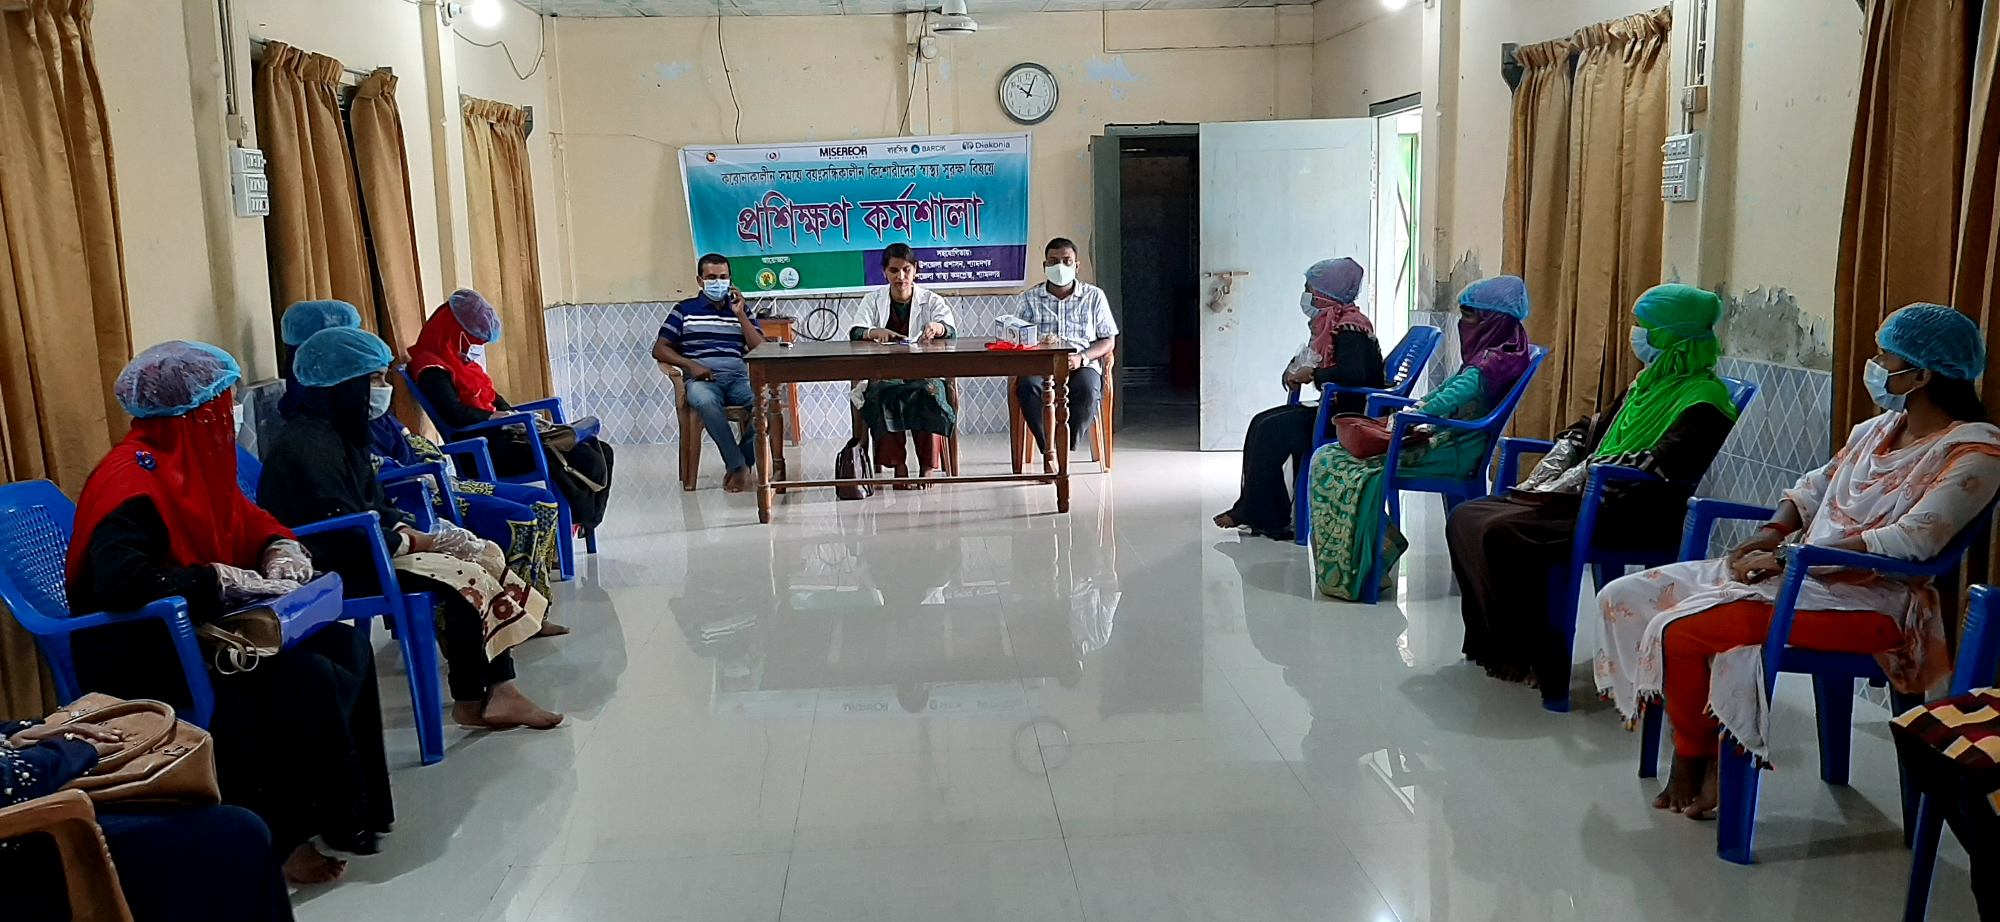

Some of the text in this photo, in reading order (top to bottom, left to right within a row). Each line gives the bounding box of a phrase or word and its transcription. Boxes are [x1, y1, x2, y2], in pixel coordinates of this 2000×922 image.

[819, 146, 868, 157] MISEREOR
[975, 141, 1010, 150] Diakonia
[720, 166, 776, 185] করোনাকালীন
[778, 169, 803, 183] সময়ে
[867, 162, 916, 179] কিশোরীদের
[919, 164, 939, 180] স্বাস্থ্য
[942, 163, 967, 179] সুরক্ষা
[969, 159, 995, 176] বিষয়ে
[737, 182, 984, 250] প্রশিক্ষণ কর্মশালা
